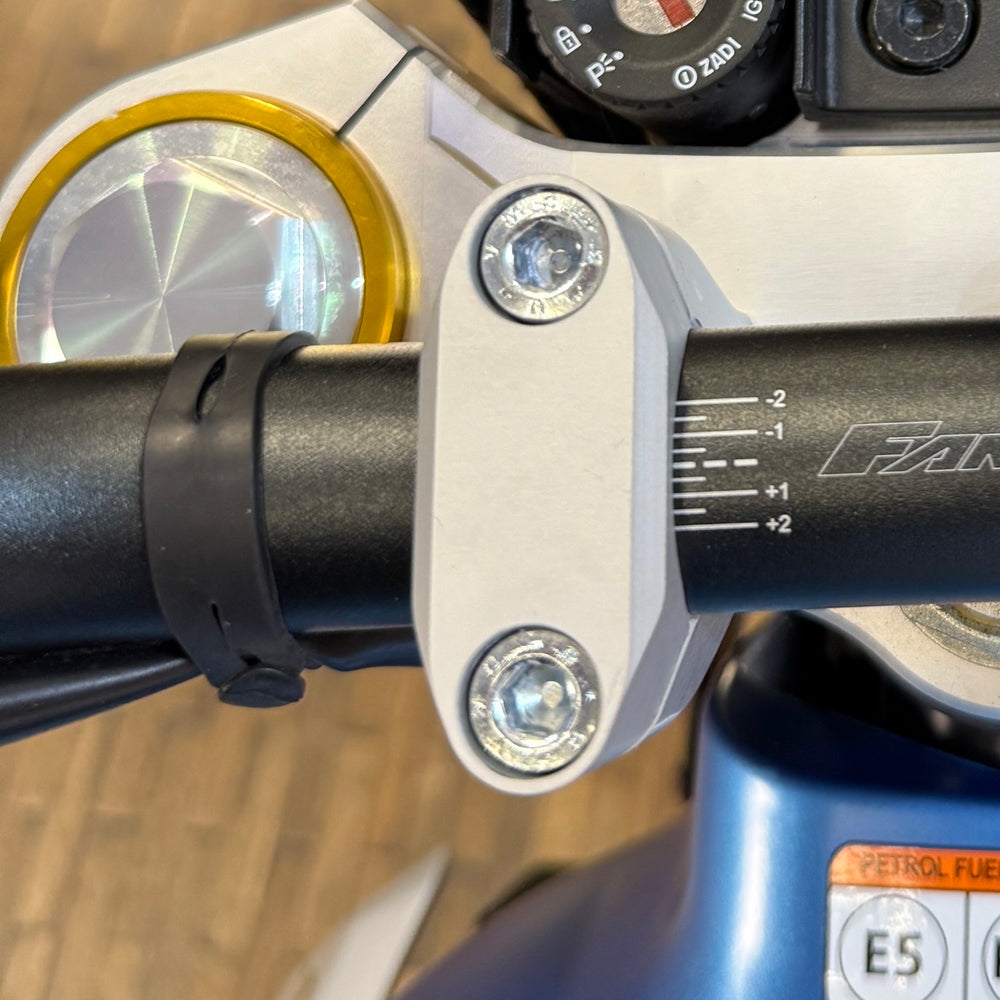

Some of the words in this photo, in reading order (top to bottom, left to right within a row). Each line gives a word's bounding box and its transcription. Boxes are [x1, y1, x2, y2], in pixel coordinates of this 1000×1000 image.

[699, 37, 742, 78] ZADI
[765, 389, 788, 408] -2
[764, 421, 784, 440] -1
[764, 481, 789, 500] +1
[765, 514, 793, 533] +2
[860, 854, 946, 878] PETROL
[864, 928, 923, 977] E5
